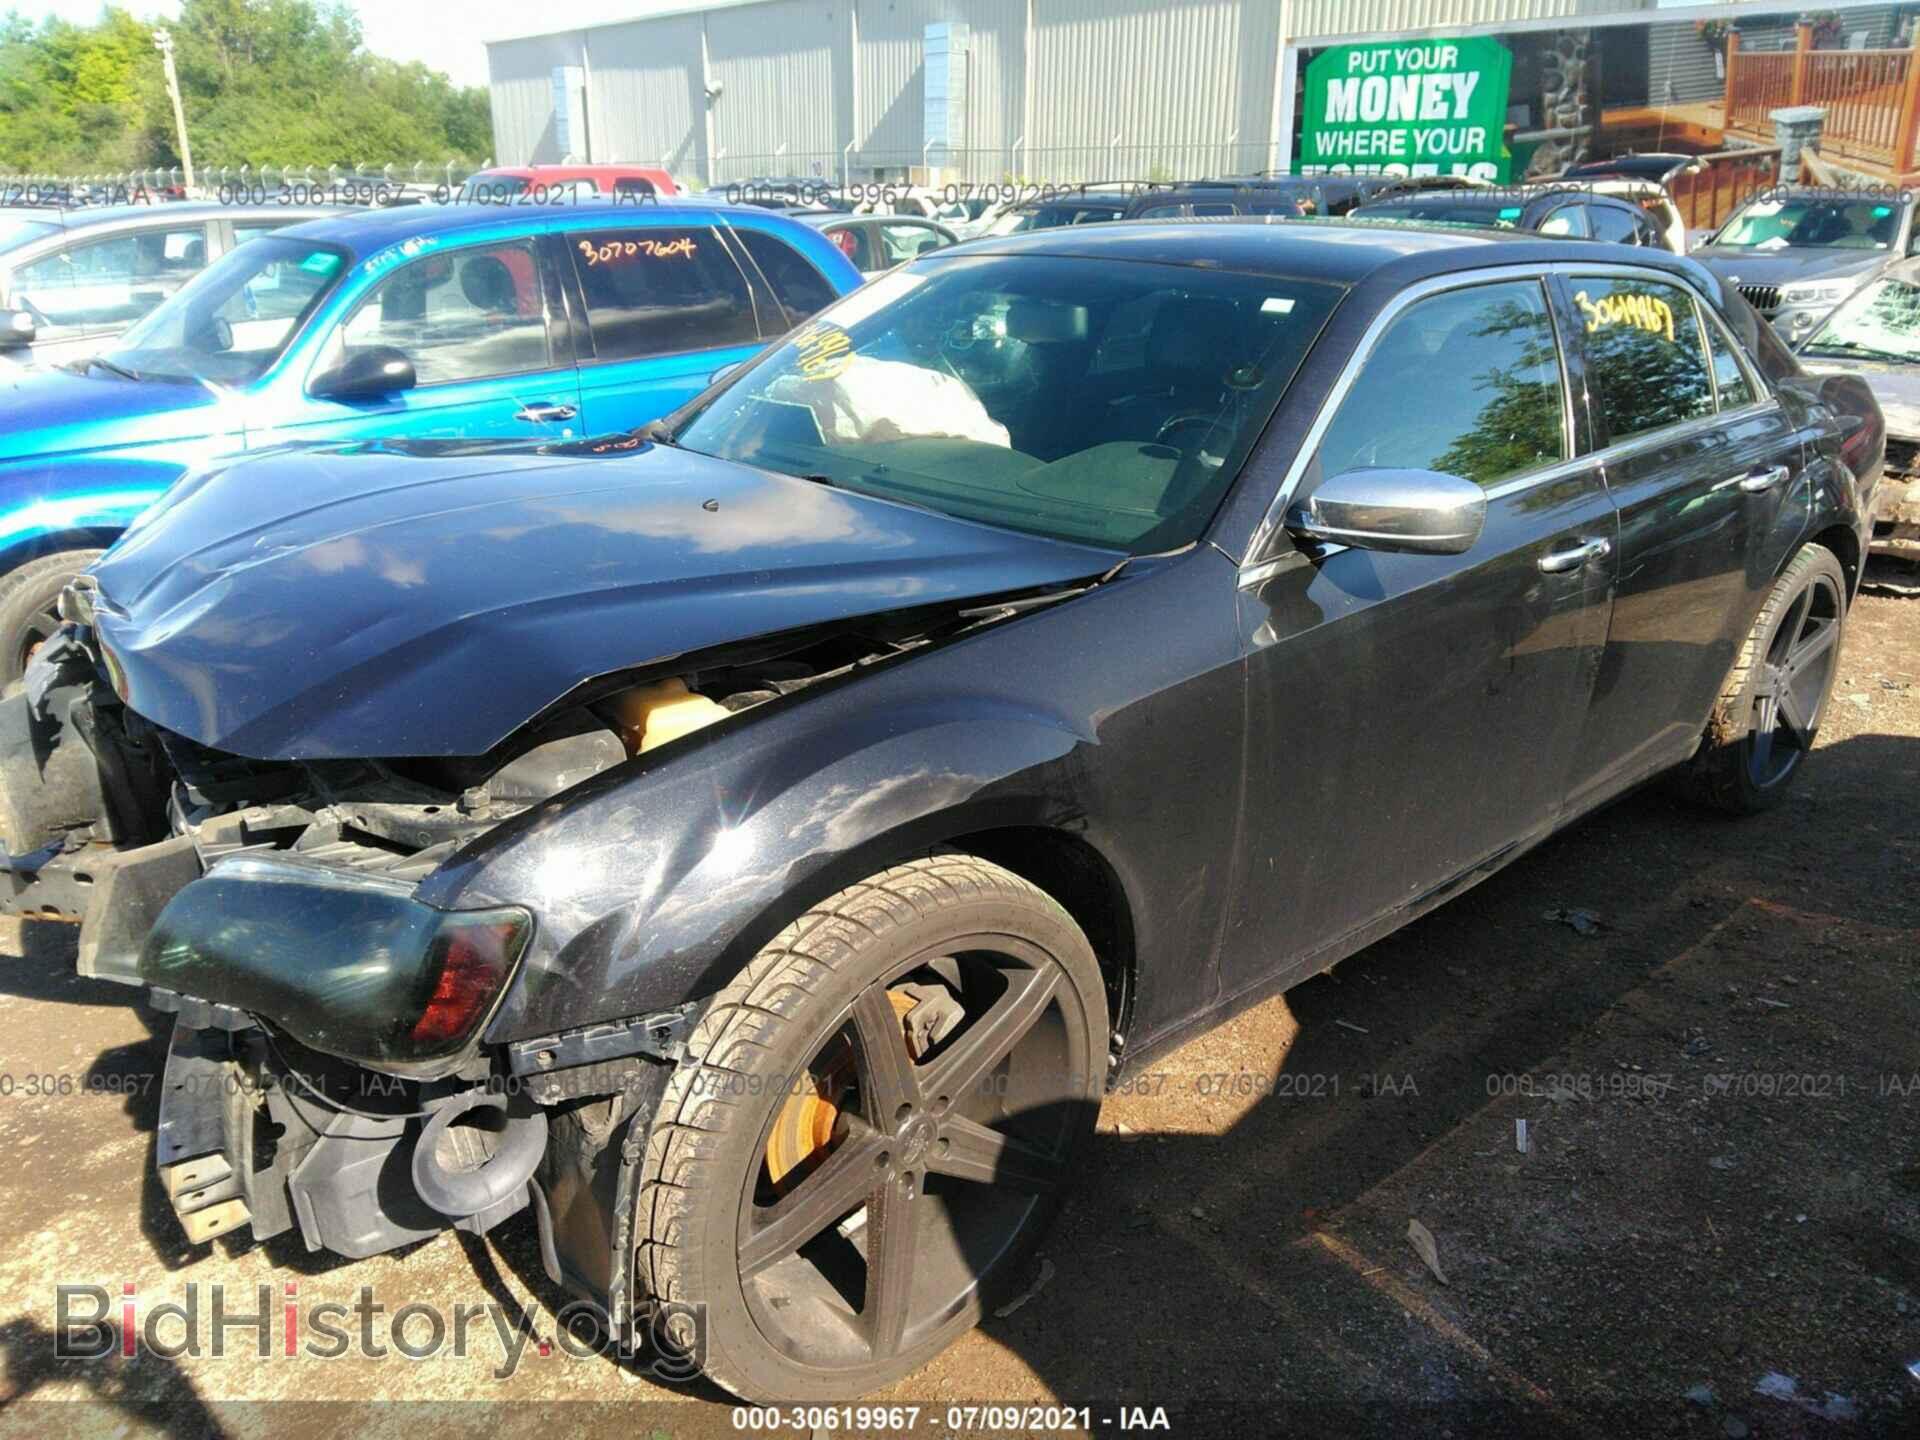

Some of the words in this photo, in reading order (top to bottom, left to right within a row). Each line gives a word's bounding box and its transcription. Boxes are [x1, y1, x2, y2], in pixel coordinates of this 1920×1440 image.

[1348, 49, 1391, 73] PUT
[1394, 46, 1458, 70] YOUR
[1324, 71, 1480, 123] MONEY
[1315, 129, 1406, 156] WHERE
[1413, 127, 1486, 154] YOUR
[579, 238, 697, 266] 30707604
